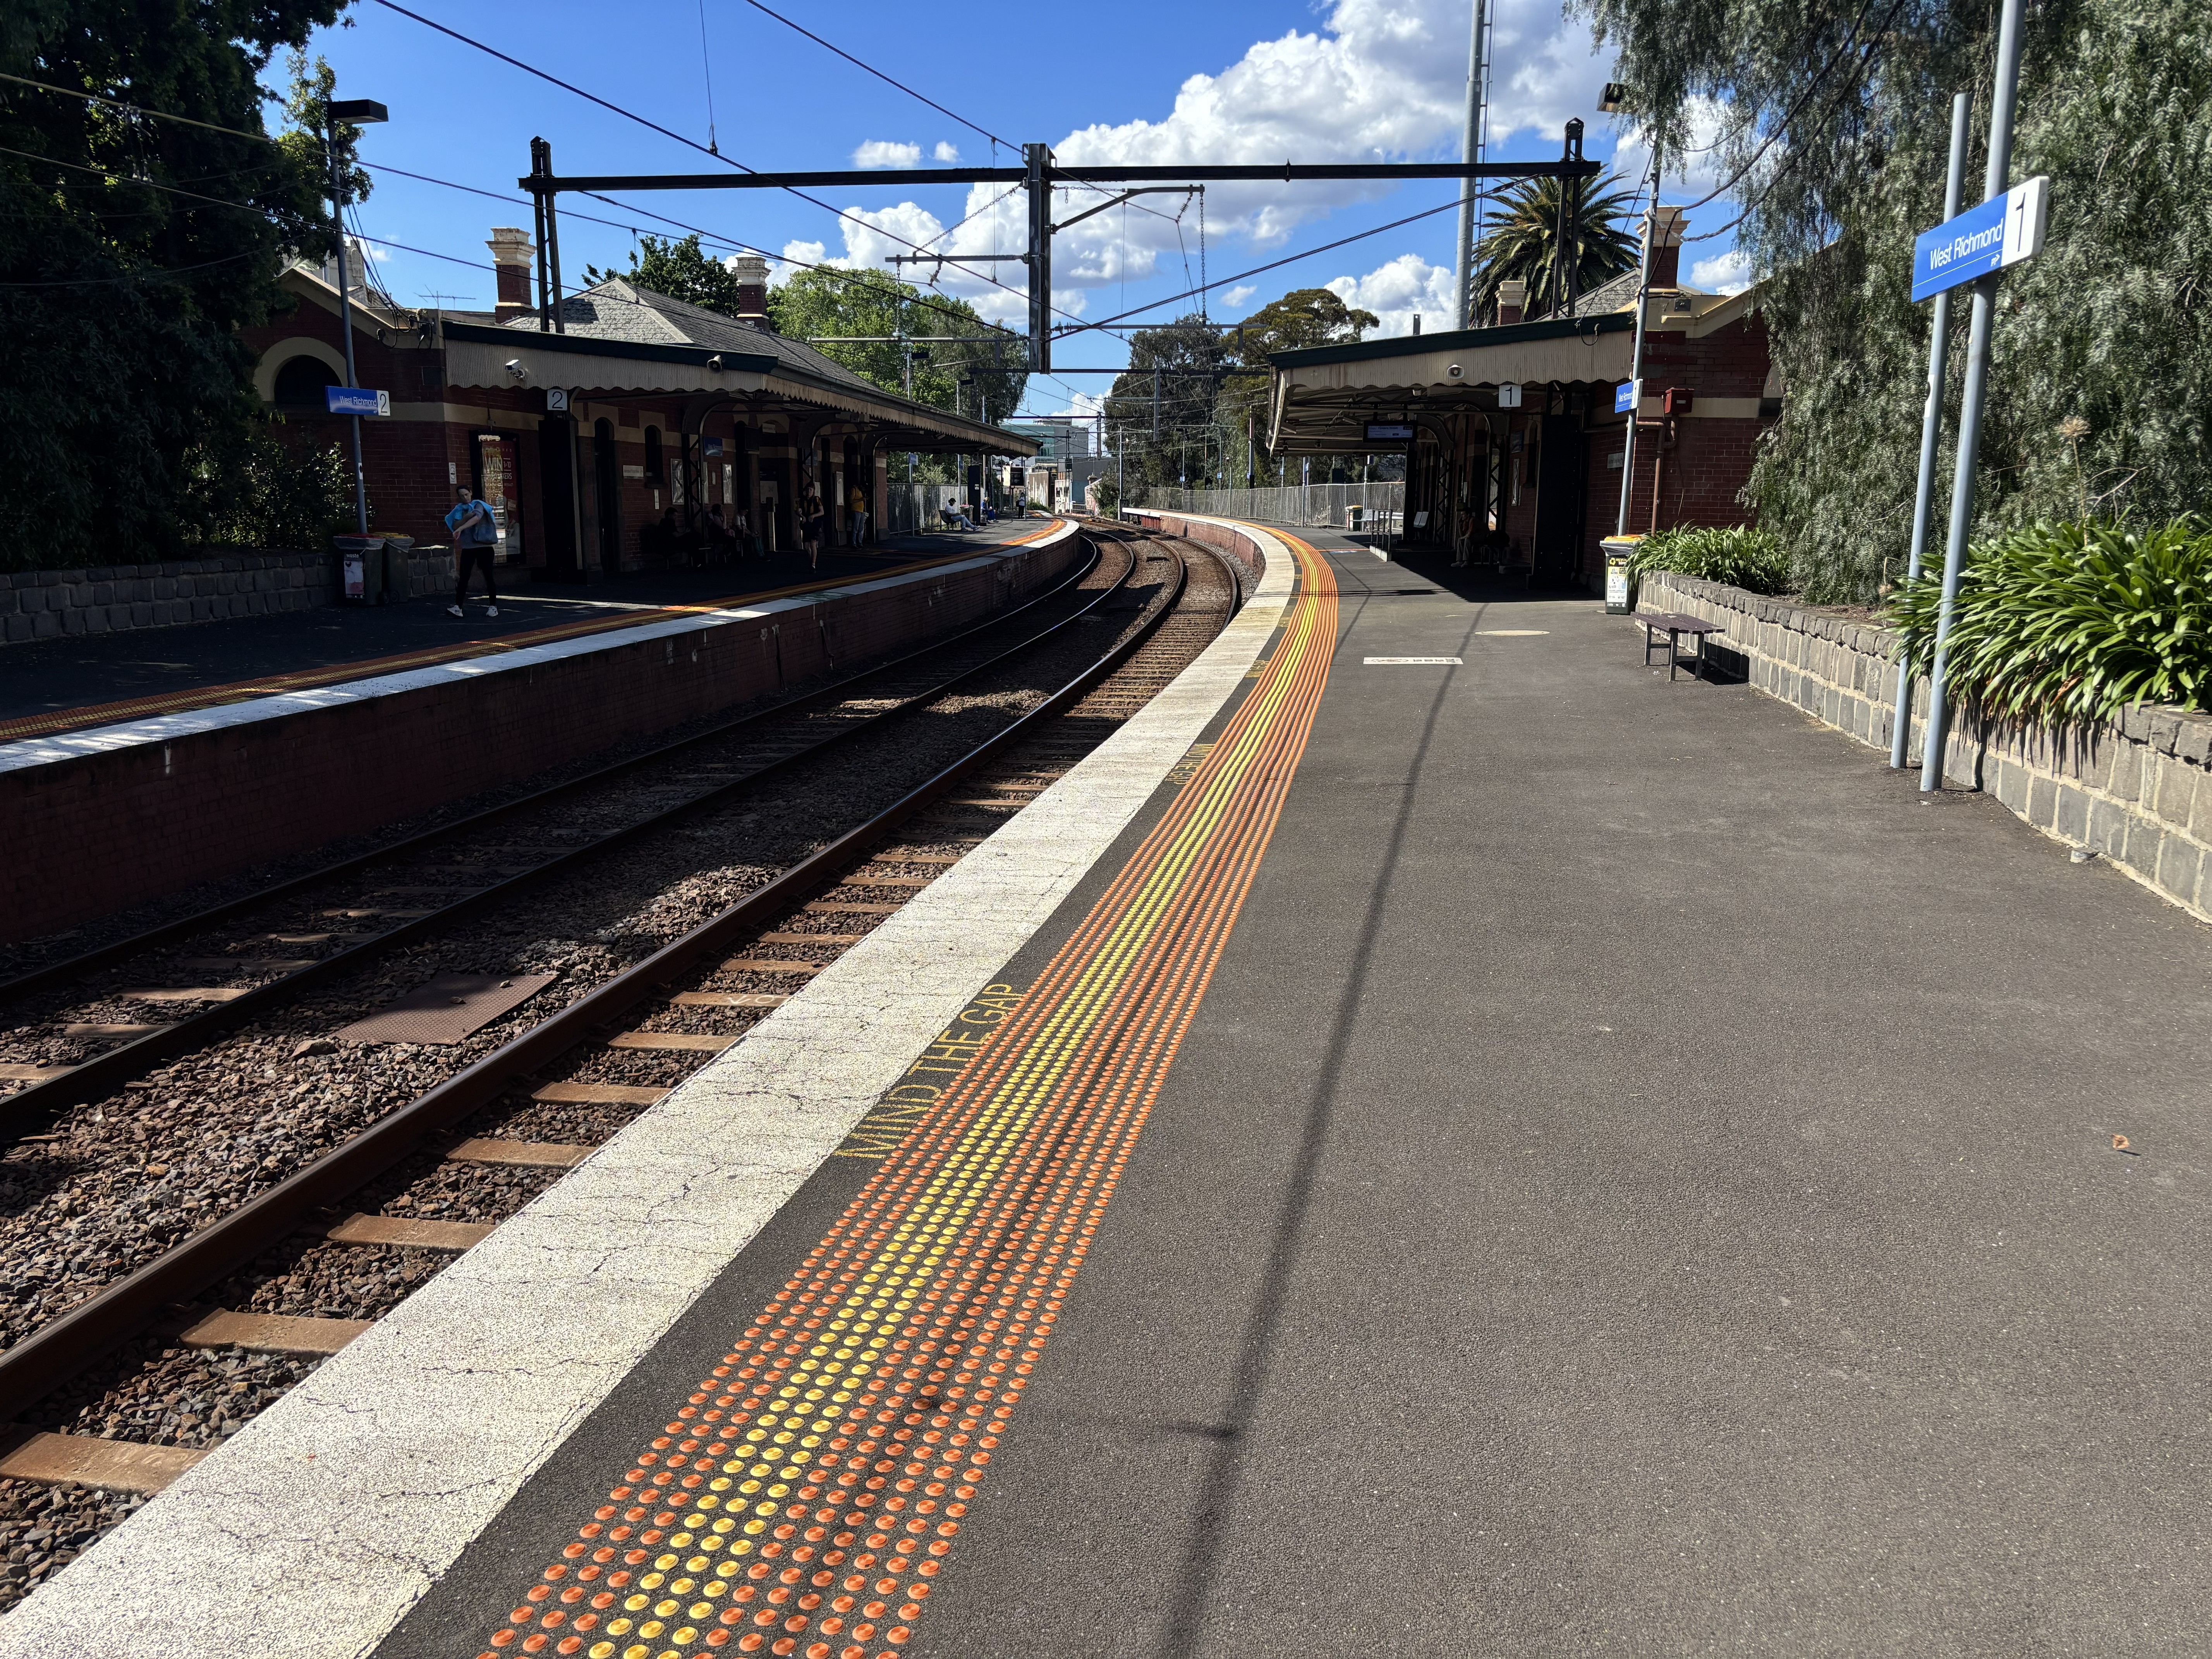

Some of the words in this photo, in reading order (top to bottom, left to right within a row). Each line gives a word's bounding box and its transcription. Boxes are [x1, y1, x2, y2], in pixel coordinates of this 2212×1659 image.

[2015, 192, 2026, 252] 1
[1930, 242, 1952, 270] West
[1953, 218, 2004, 260] Richmond
[339, 395, 352, 405] West
[353, 397, 377, 406] Richmond
[380, 393, 388, 413] 2
[552, 391, 563, 409] 2
[1505, 386, 1512, 405] 1
[485, 457, 503, 471] WIN
[935, 455, 941, 464] 2
[1186, 743, 1216, 757] MIND
[1175, 759, 1203, 770] THE
[1164, 771, 1195, 785] GAP
[833, 1084, 941, 1159] MIND
[908, 1029, 991, 1076] THE
[959, 983, 1026, 1025] GAP
